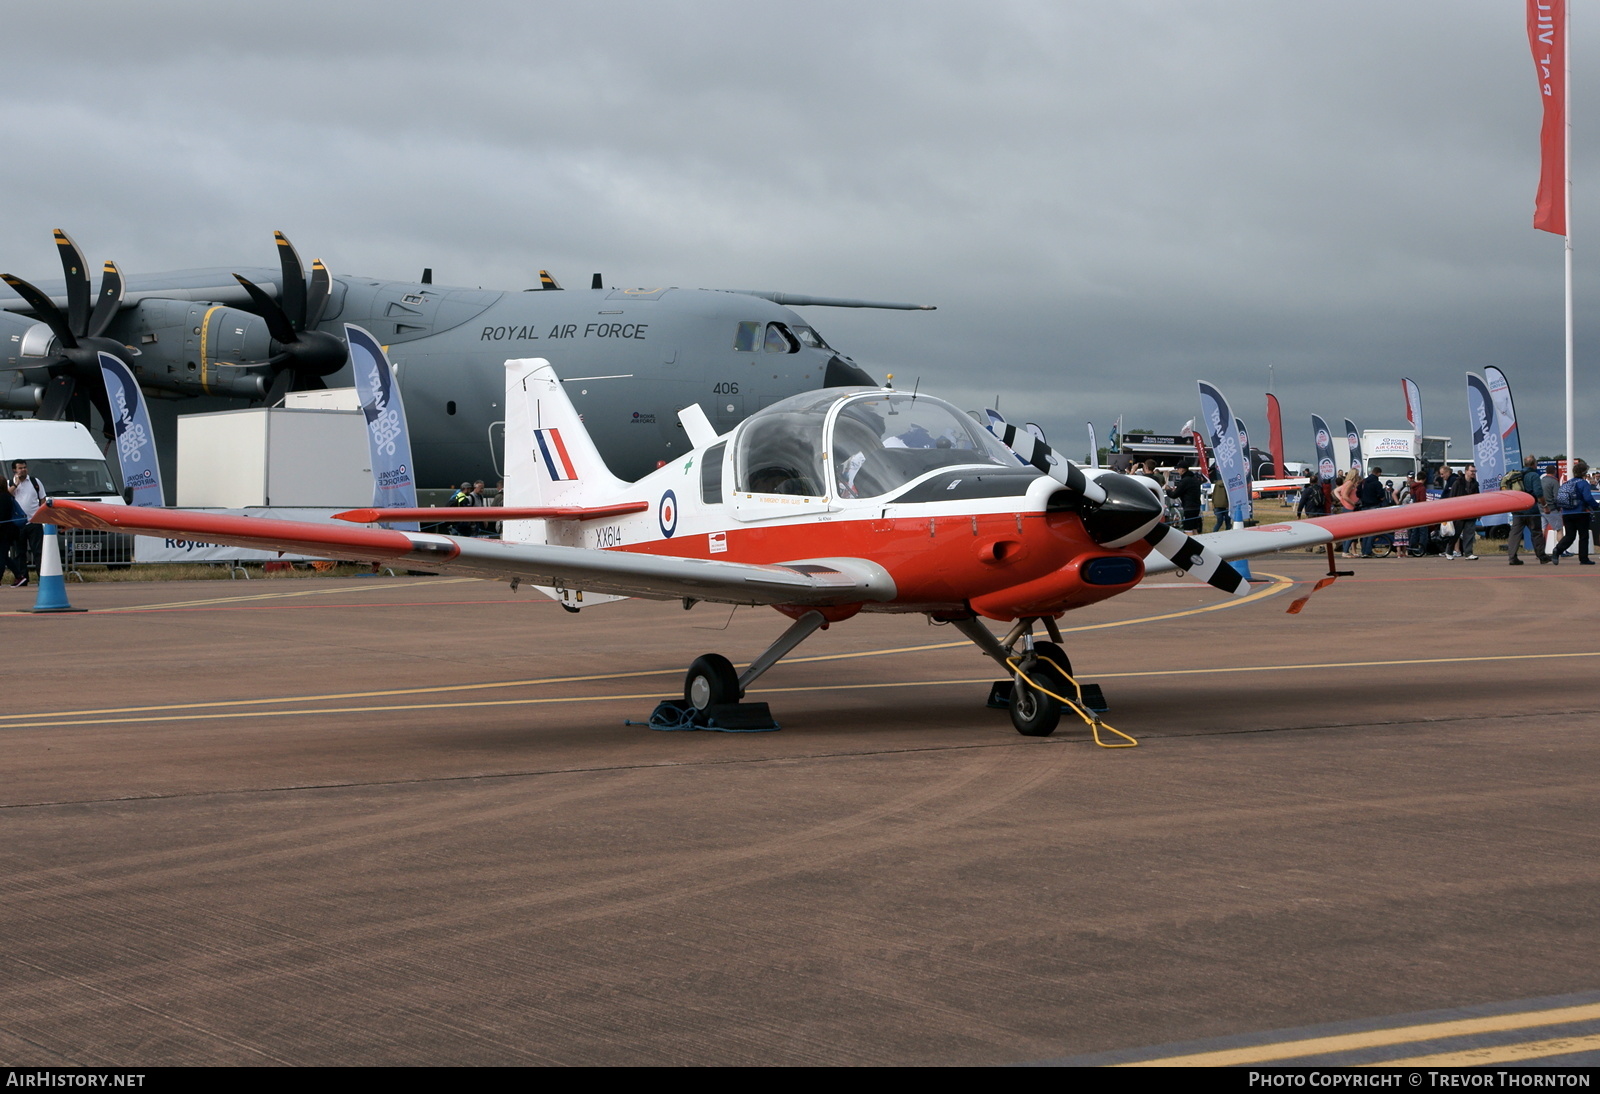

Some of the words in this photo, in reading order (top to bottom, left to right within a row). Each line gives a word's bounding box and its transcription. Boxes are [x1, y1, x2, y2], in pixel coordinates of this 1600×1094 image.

[481, 326, 539, 340] ROYAL
[548, 324, 577, 338] AIR
[584, 324, 648, 339] FORCE
[713, 382, 739, 394] 406
[596, 526, 621, 548] XX614
